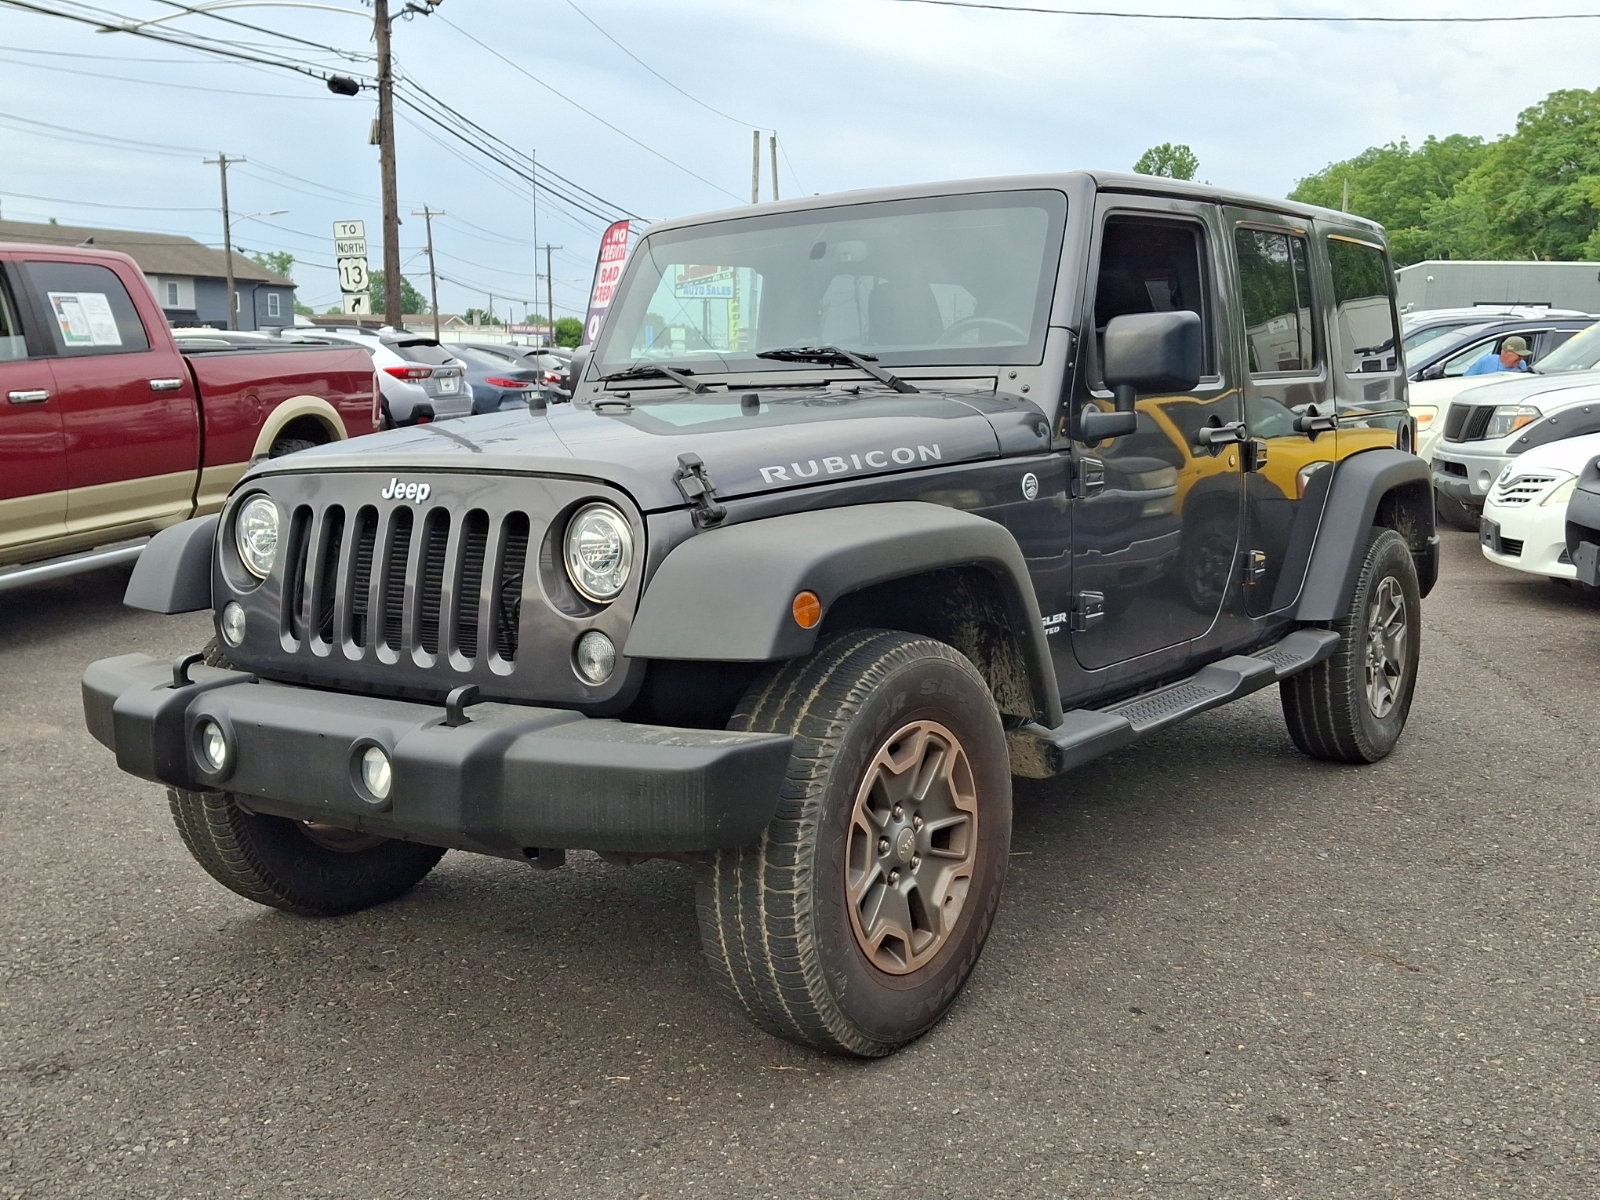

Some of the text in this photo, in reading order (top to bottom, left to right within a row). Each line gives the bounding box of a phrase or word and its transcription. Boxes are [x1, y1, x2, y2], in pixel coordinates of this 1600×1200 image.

[341, 224, 357, 235] TO
[612, 228, 626, 243] NO
[337, 242, 365, 254] NORTH
[344, 265, 363, 285] 13
[601, 266, 620, 283] BAD
[683, 284, 732, 296] AUTO SALES
[588, 314, 603, 340] O
[759, 443, 942, 484] RUBICON
[381, 477, 431, 505] Jeep
